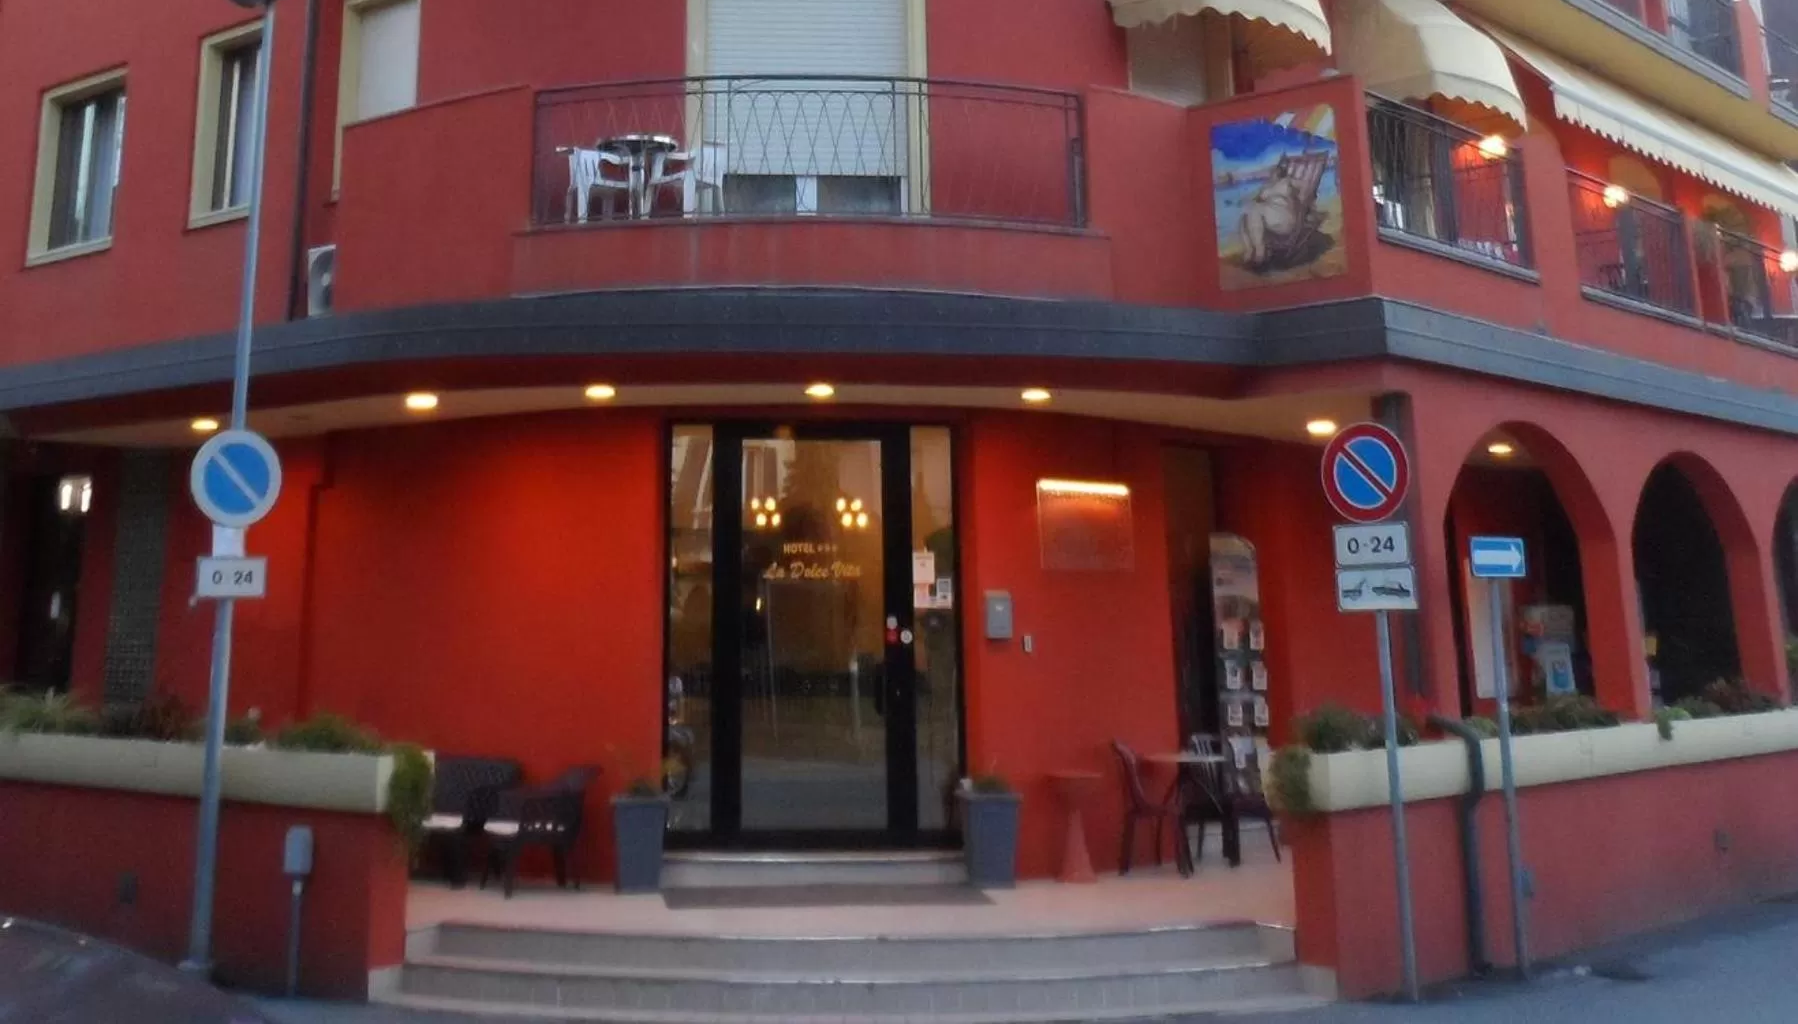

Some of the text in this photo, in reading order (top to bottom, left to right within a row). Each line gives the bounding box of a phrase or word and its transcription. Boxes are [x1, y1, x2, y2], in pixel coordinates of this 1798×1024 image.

[783, 542, 816, 554] HOTEL
[762, 560, 862, 580] La Dolce Vita
